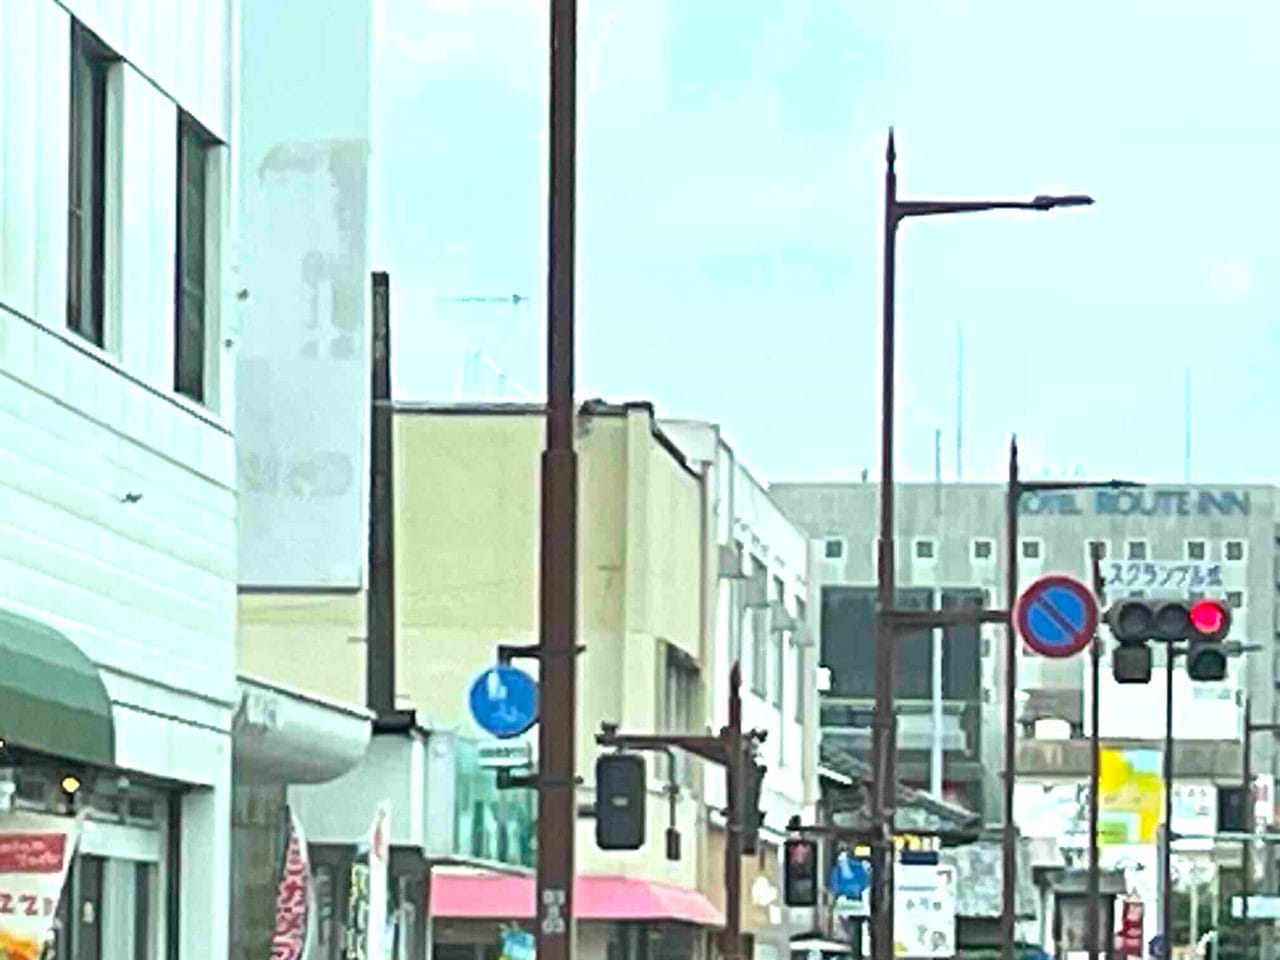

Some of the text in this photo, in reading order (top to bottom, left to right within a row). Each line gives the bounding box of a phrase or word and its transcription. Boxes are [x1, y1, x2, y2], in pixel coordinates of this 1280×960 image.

[1019, 491, 1250, 516] OTEL ROUTE INN
